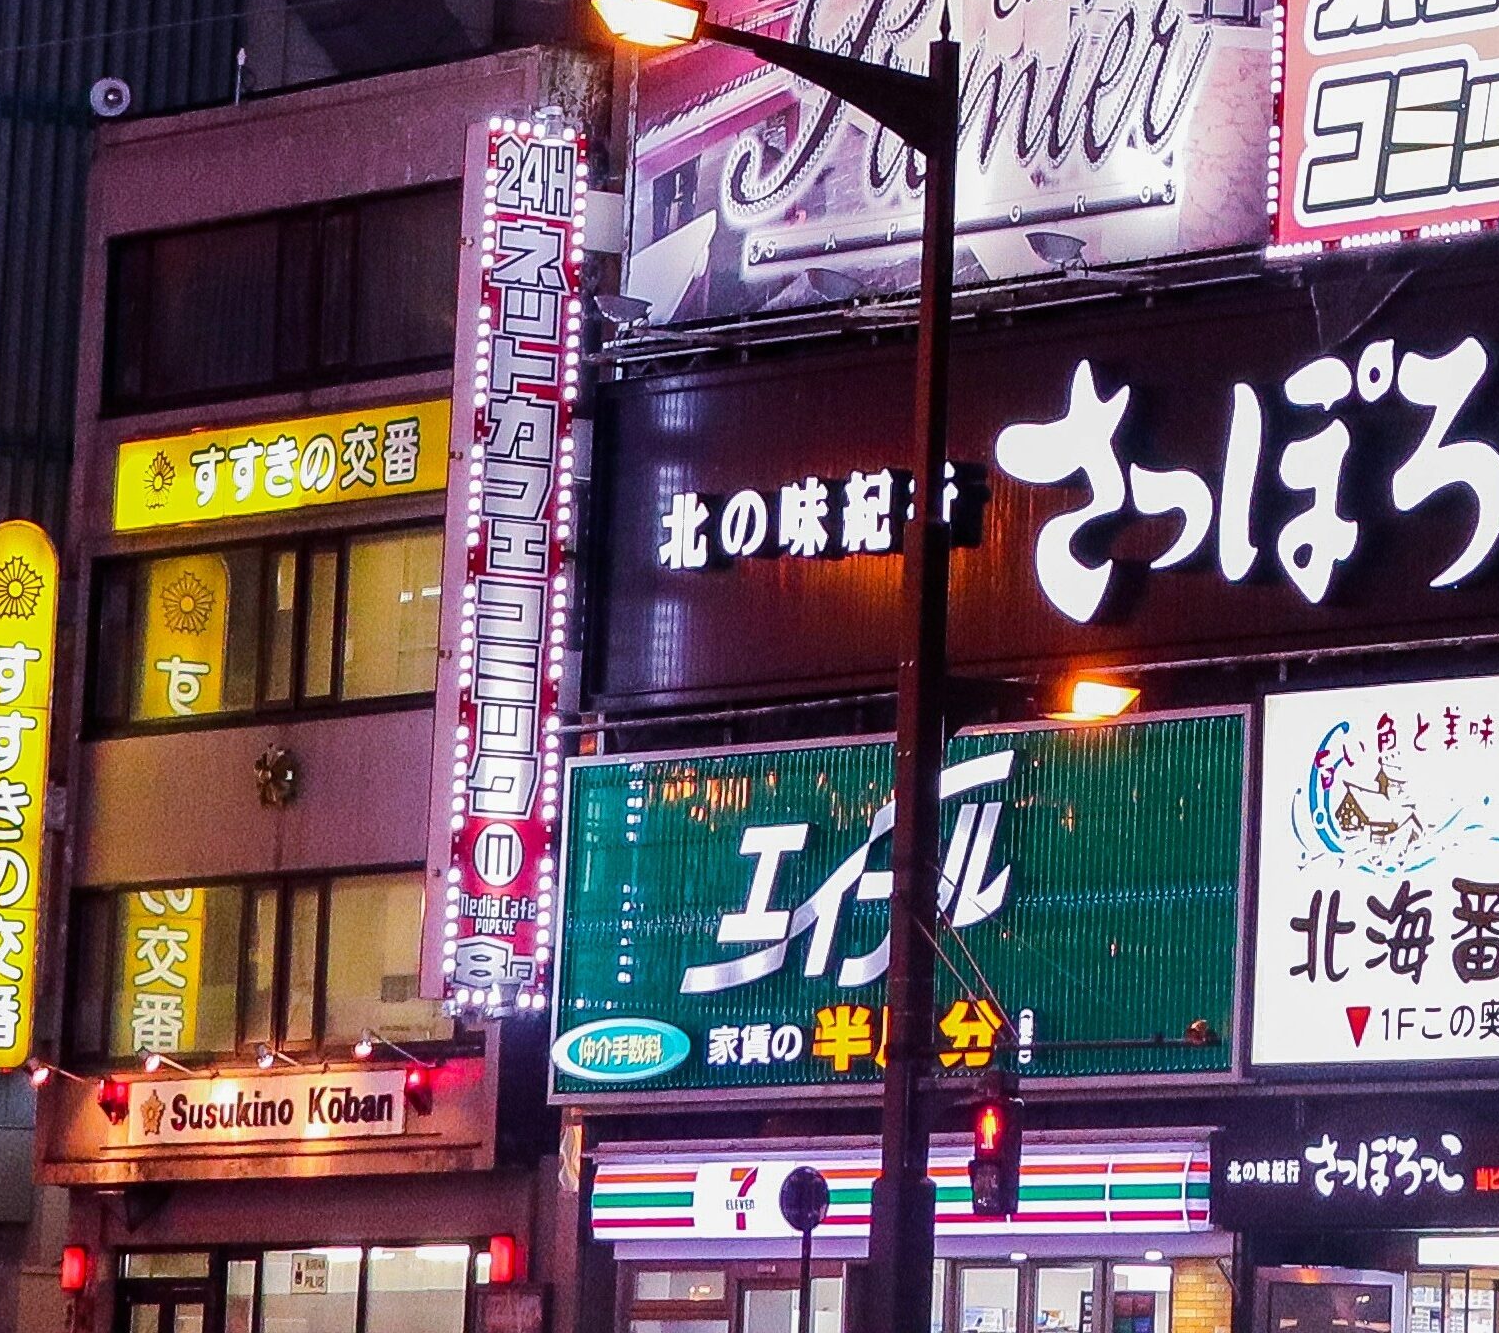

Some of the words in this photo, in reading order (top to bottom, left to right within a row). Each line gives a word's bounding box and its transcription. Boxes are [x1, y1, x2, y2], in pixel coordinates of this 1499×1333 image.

[495, 135, 576, 218] 24H
[190, 414, 422, 507] すすきの交番
[501, 894, 537, 921] Cafe
[576, 1034, 663, 1068] 仲介手数料
[707, 998, 1003, 1074] 家賃の半分
[169, 1094, 295, 1134] Susukino
[1226, 1159, 1300, 1185] 北の味紀行
[1304, 1133, 1466, 1198] さっぽろっこ
